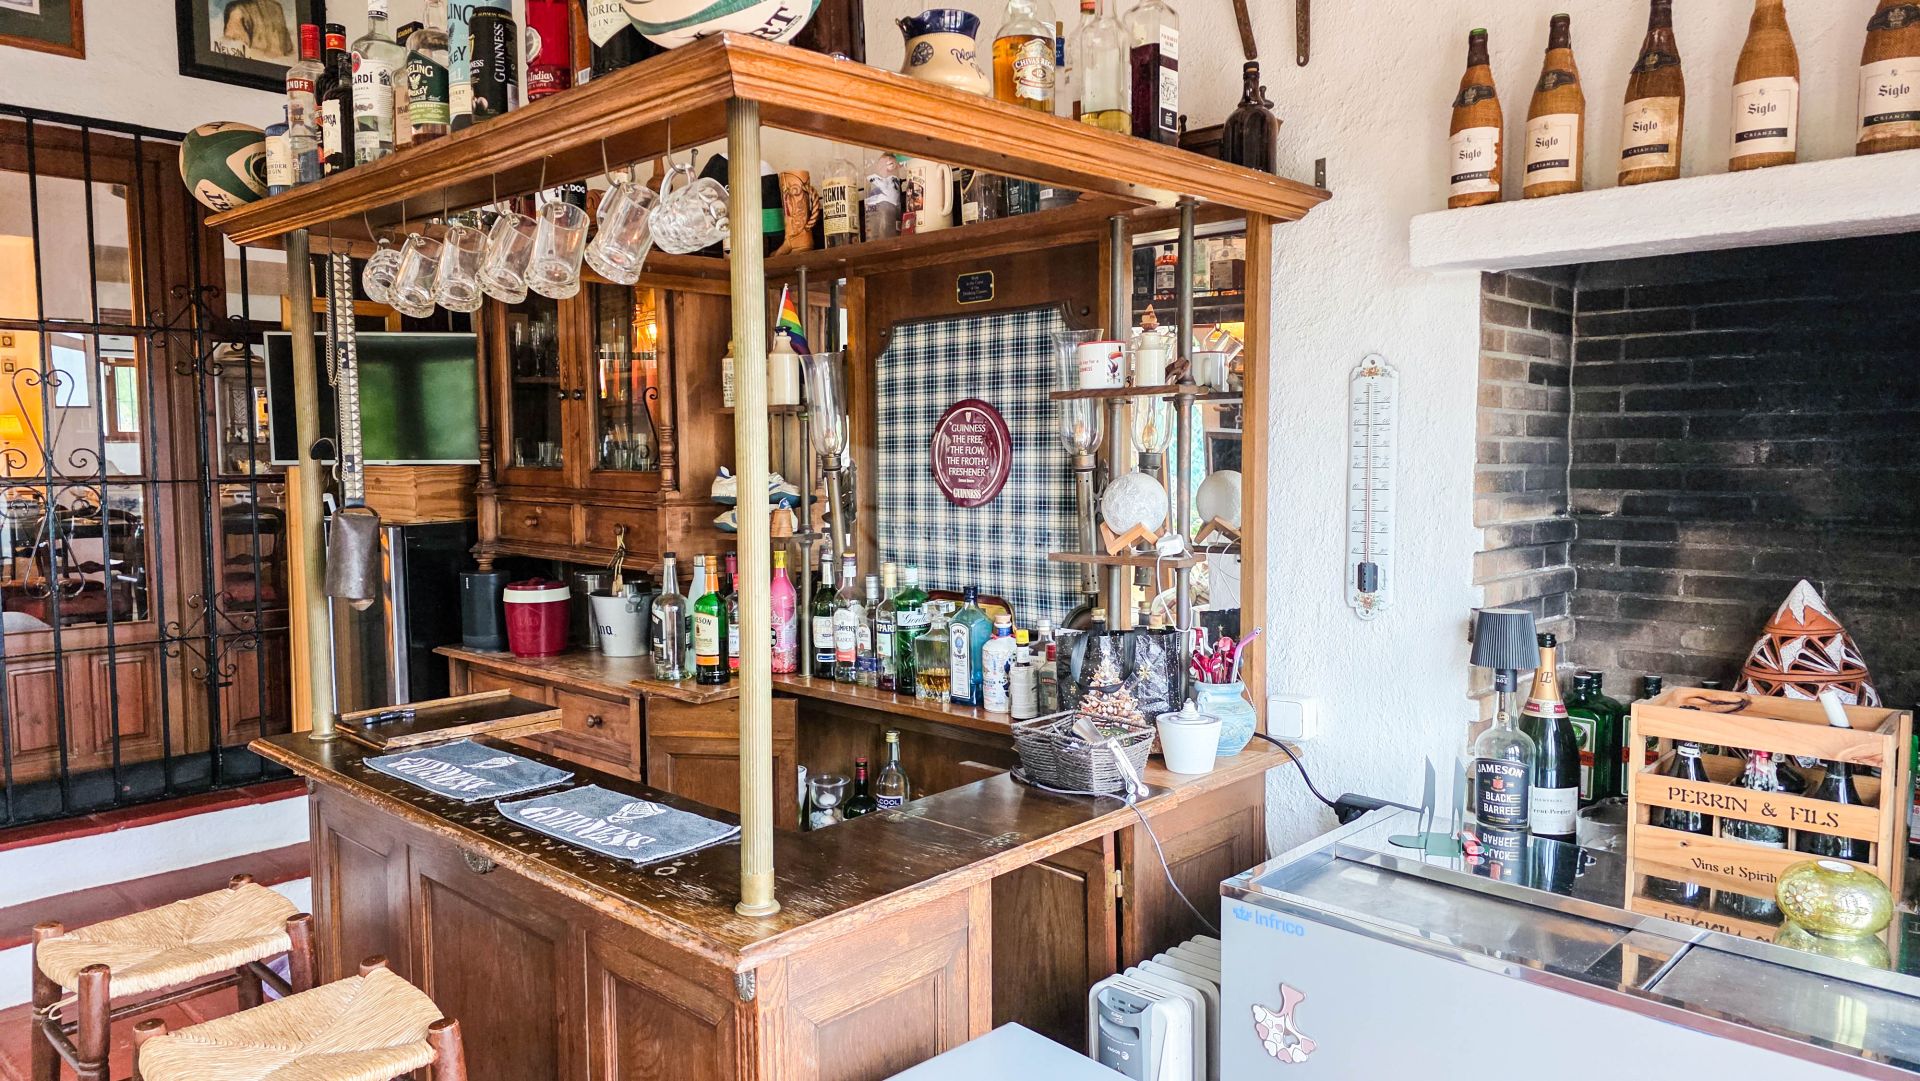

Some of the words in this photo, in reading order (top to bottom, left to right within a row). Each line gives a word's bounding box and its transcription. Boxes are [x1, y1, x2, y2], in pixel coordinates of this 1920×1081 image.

[214, 40, 246, 59] NELSON
[493, 21, 506, 83] GUINNESS
[1014, 59, 1039, 70] CHIVAS
[1877, 83, 1910, 99] Siglo
[1747, 101, 1777, 117] Siglo
[1632, 120, 1658, 135] Siglo
[1535, 136, 1559, 149] Siglo
[1459, 149, 1482, 161] Siglo
[835, 202, 846, 213] Gin
[952, 434, 966, 444] THE
[950, 446, 964, 454] THE
[946, 456, 960, 465] THE
[961, 457, 989, 466] FROTHY
[953, 488, 982, 499] GUINNESS
[387, 756, 496, 792] GUINNESS
[1478, 763, 1525, 778] JAMESON
[1485, 791, 1512, 803] BLACK
[1483, 803, 1514, 816] BARREL
[1667, 785, 1748, 813] PERRIN
[1760, 801, 1778, 818] &
[1789, 805, 1840, 829] FILS
[519, 805, 656, 851] GUINNESS
[1691, 857, 1719, 873] Vins
[1723, 865, 1735, 876] et
[1255, 909, 1306, 937] Infrico
